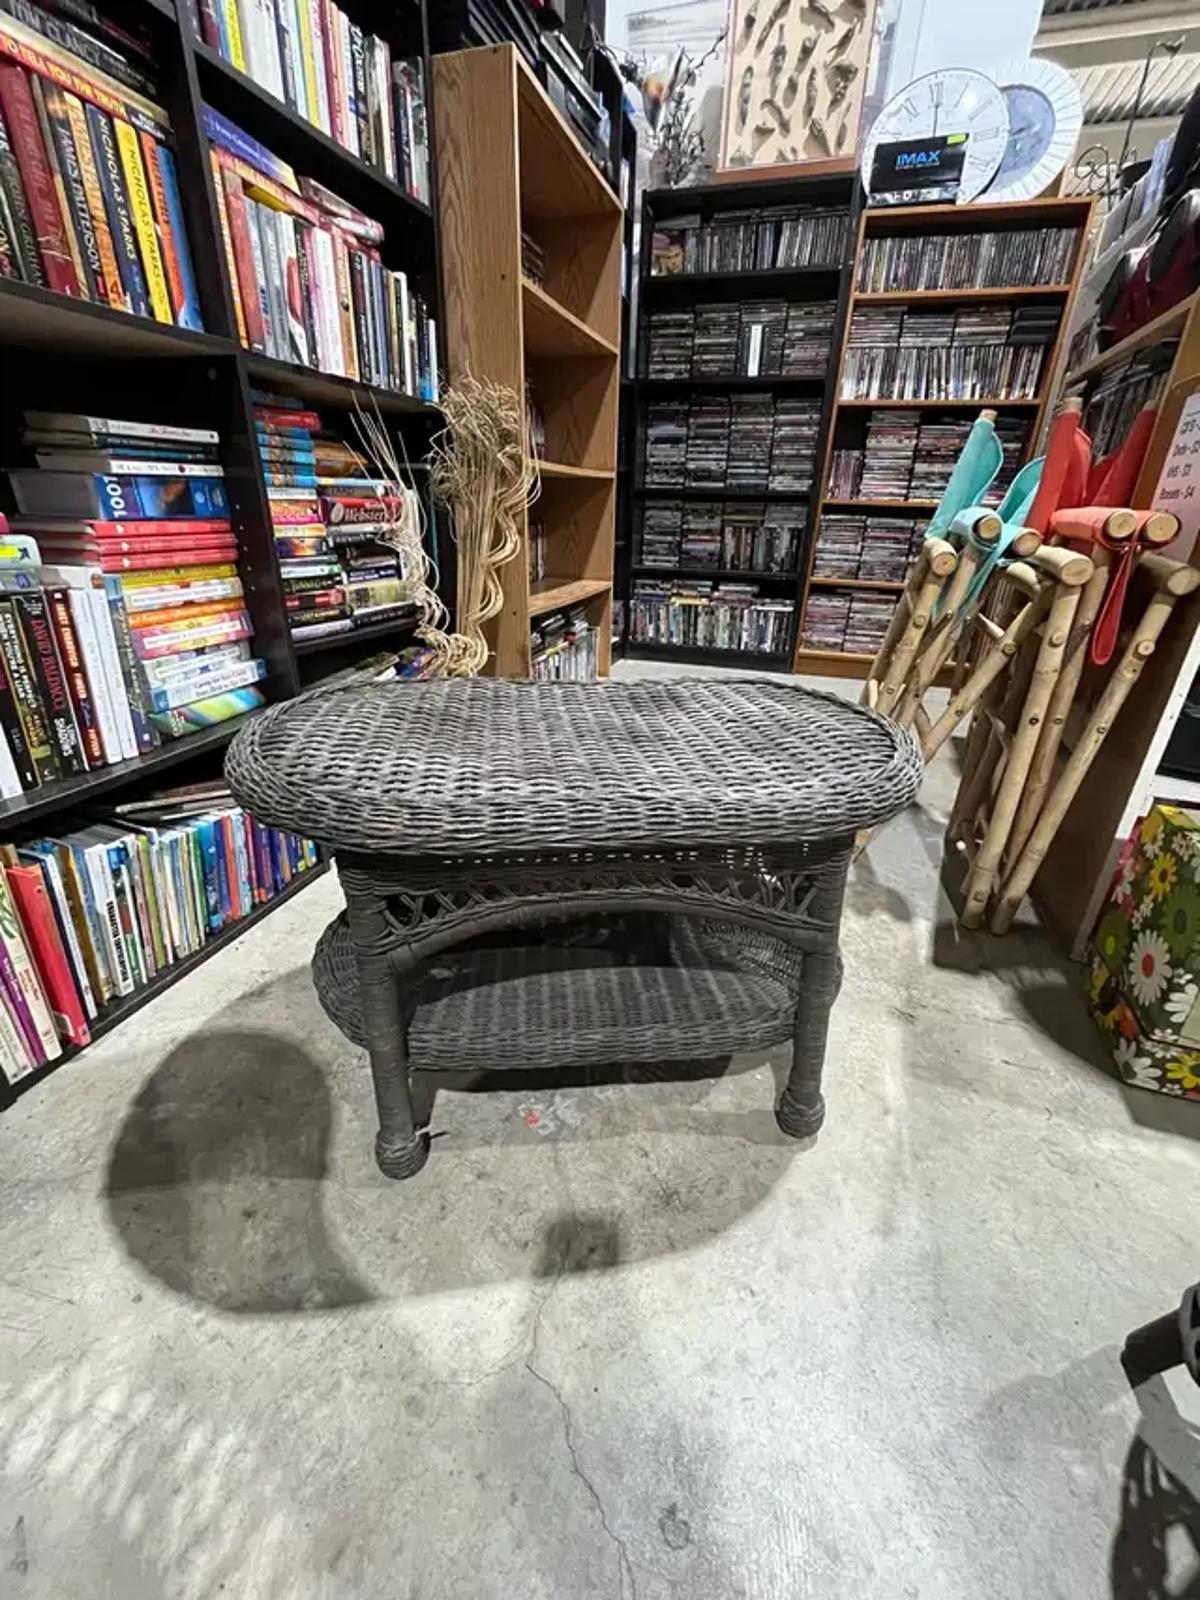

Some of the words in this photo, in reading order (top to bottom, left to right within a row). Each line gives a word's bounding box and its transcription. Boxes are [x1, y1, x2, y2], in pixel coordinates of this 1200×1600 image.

[46, 20, 100, 66] CLANCY
[98, 114, 125, 204] NICHOLAS
[118, 207, 136, 260] SPARKS
[896, 150, 941, 166] IMAX
[57, 126, 80, 181] JAMES
[72, 181, 101, 272] PATTERSON
[129, 149, 151, 227] NICHOLAS
[146, 228, 161, 284] SPARKS
[106, 476, 126, 518] 1001
[55, 603, 70, 631] JANET
[61, 628, 79, 667] EVANOVICH
[4, 612, 25, 665] EVERYTHING
[19, 673, 37, 709] PERFECT
[31, 618, 50, 657] DAVID
[42, 656, 64, 712] BALDACCI
